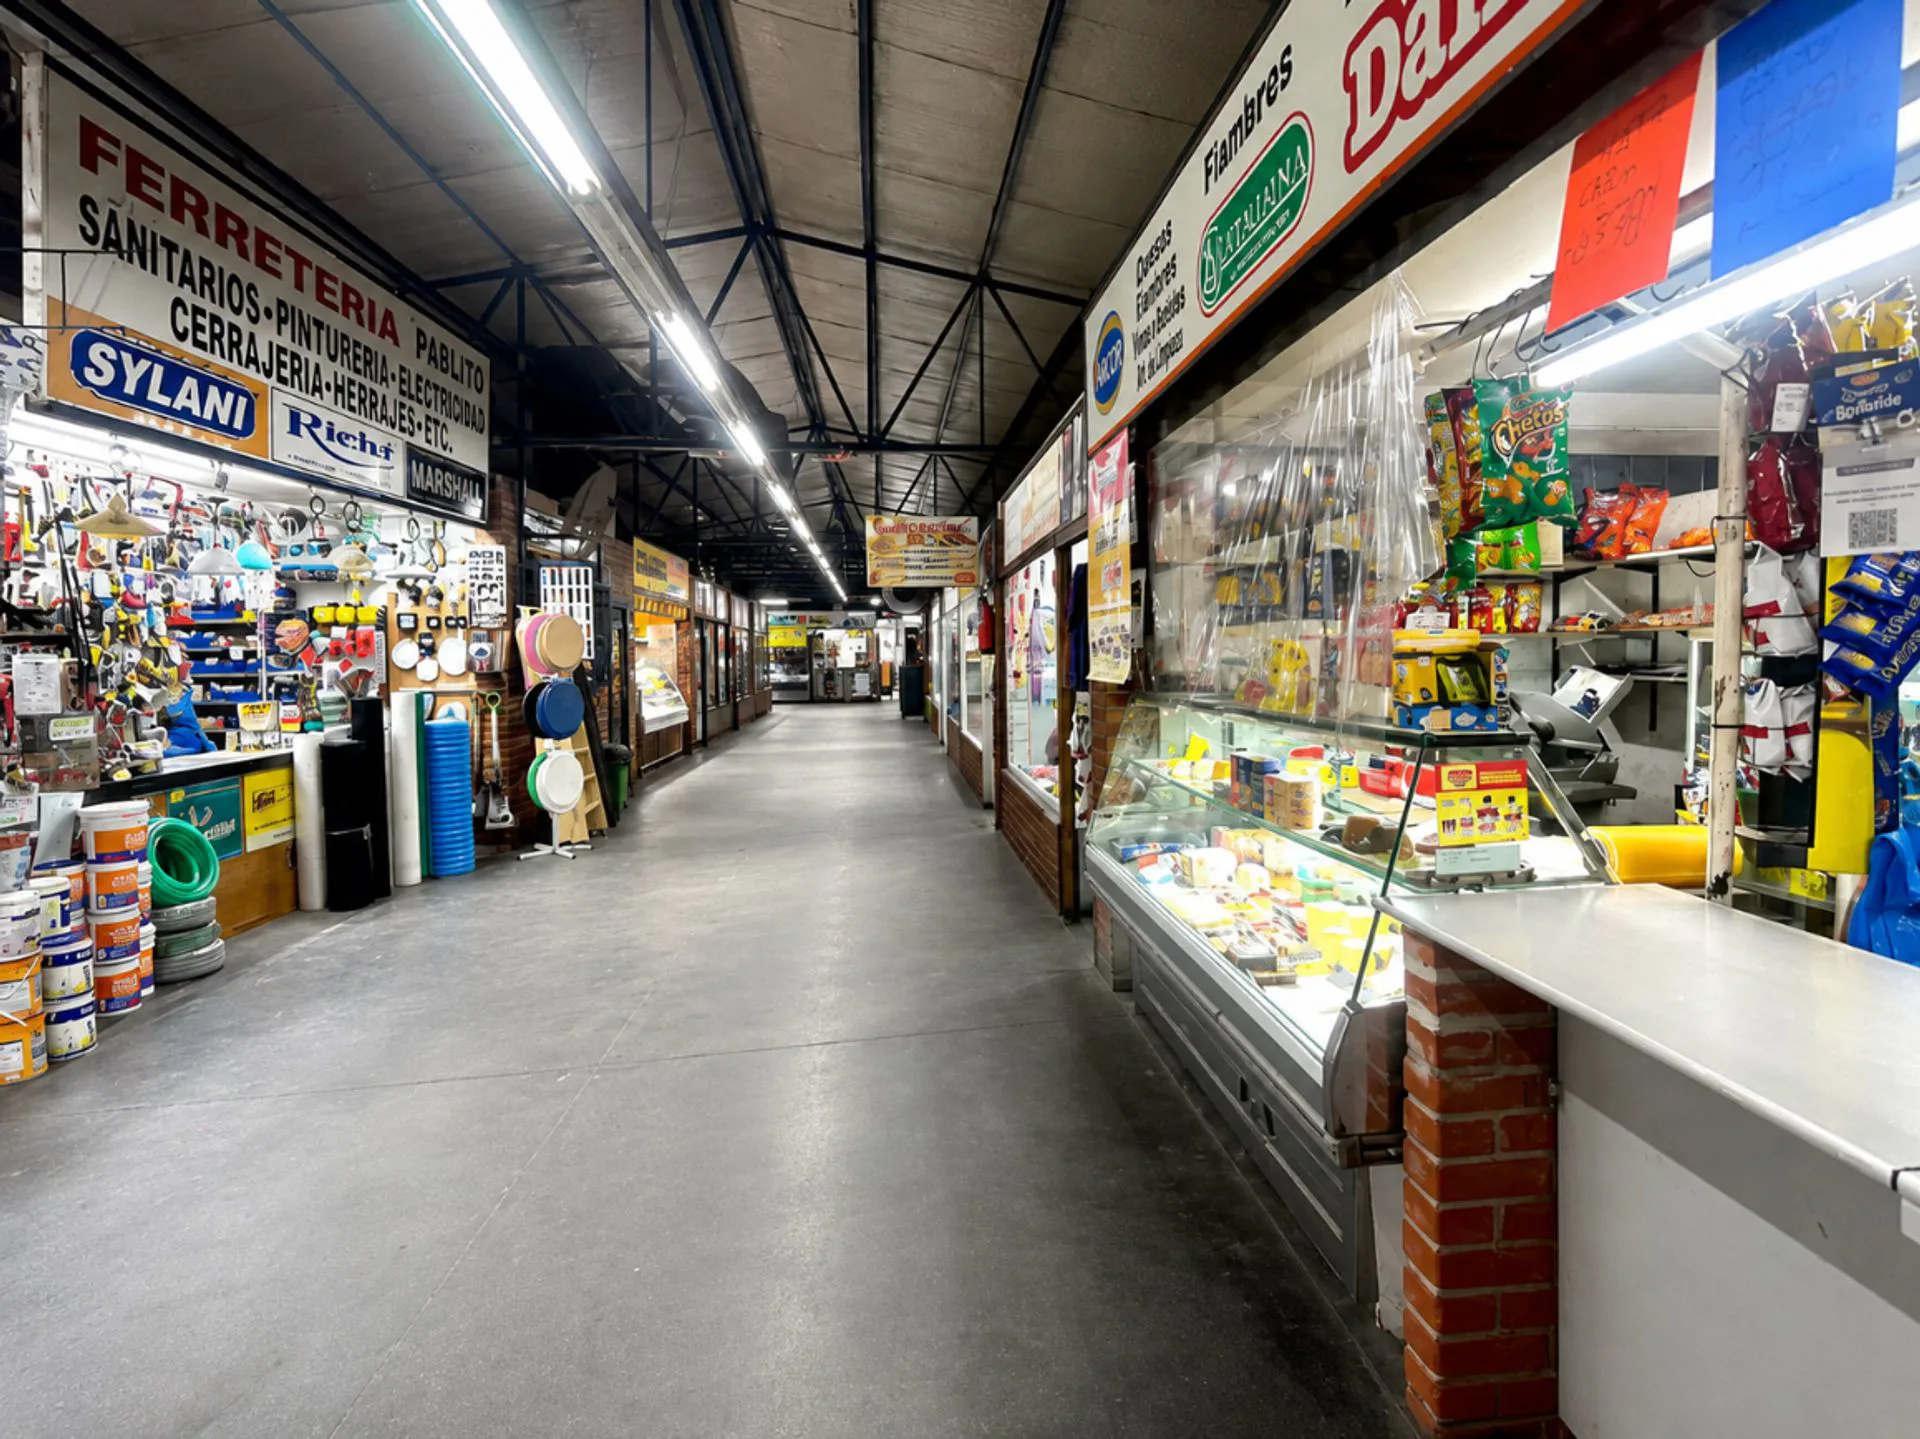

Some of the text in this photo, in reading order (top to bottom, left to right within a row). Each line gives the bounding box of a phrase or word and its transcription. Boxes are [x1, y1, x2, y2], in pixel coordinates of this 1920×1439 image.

[1204, 44, 1293, 196] Fiambres
[79, 115, 400, 347] FERRETERIA
[83, 342, 248, 431] SYLANI
[416, 325, 484, 395] PABLITO
[411, 460, 482, 502] MARSHALL
